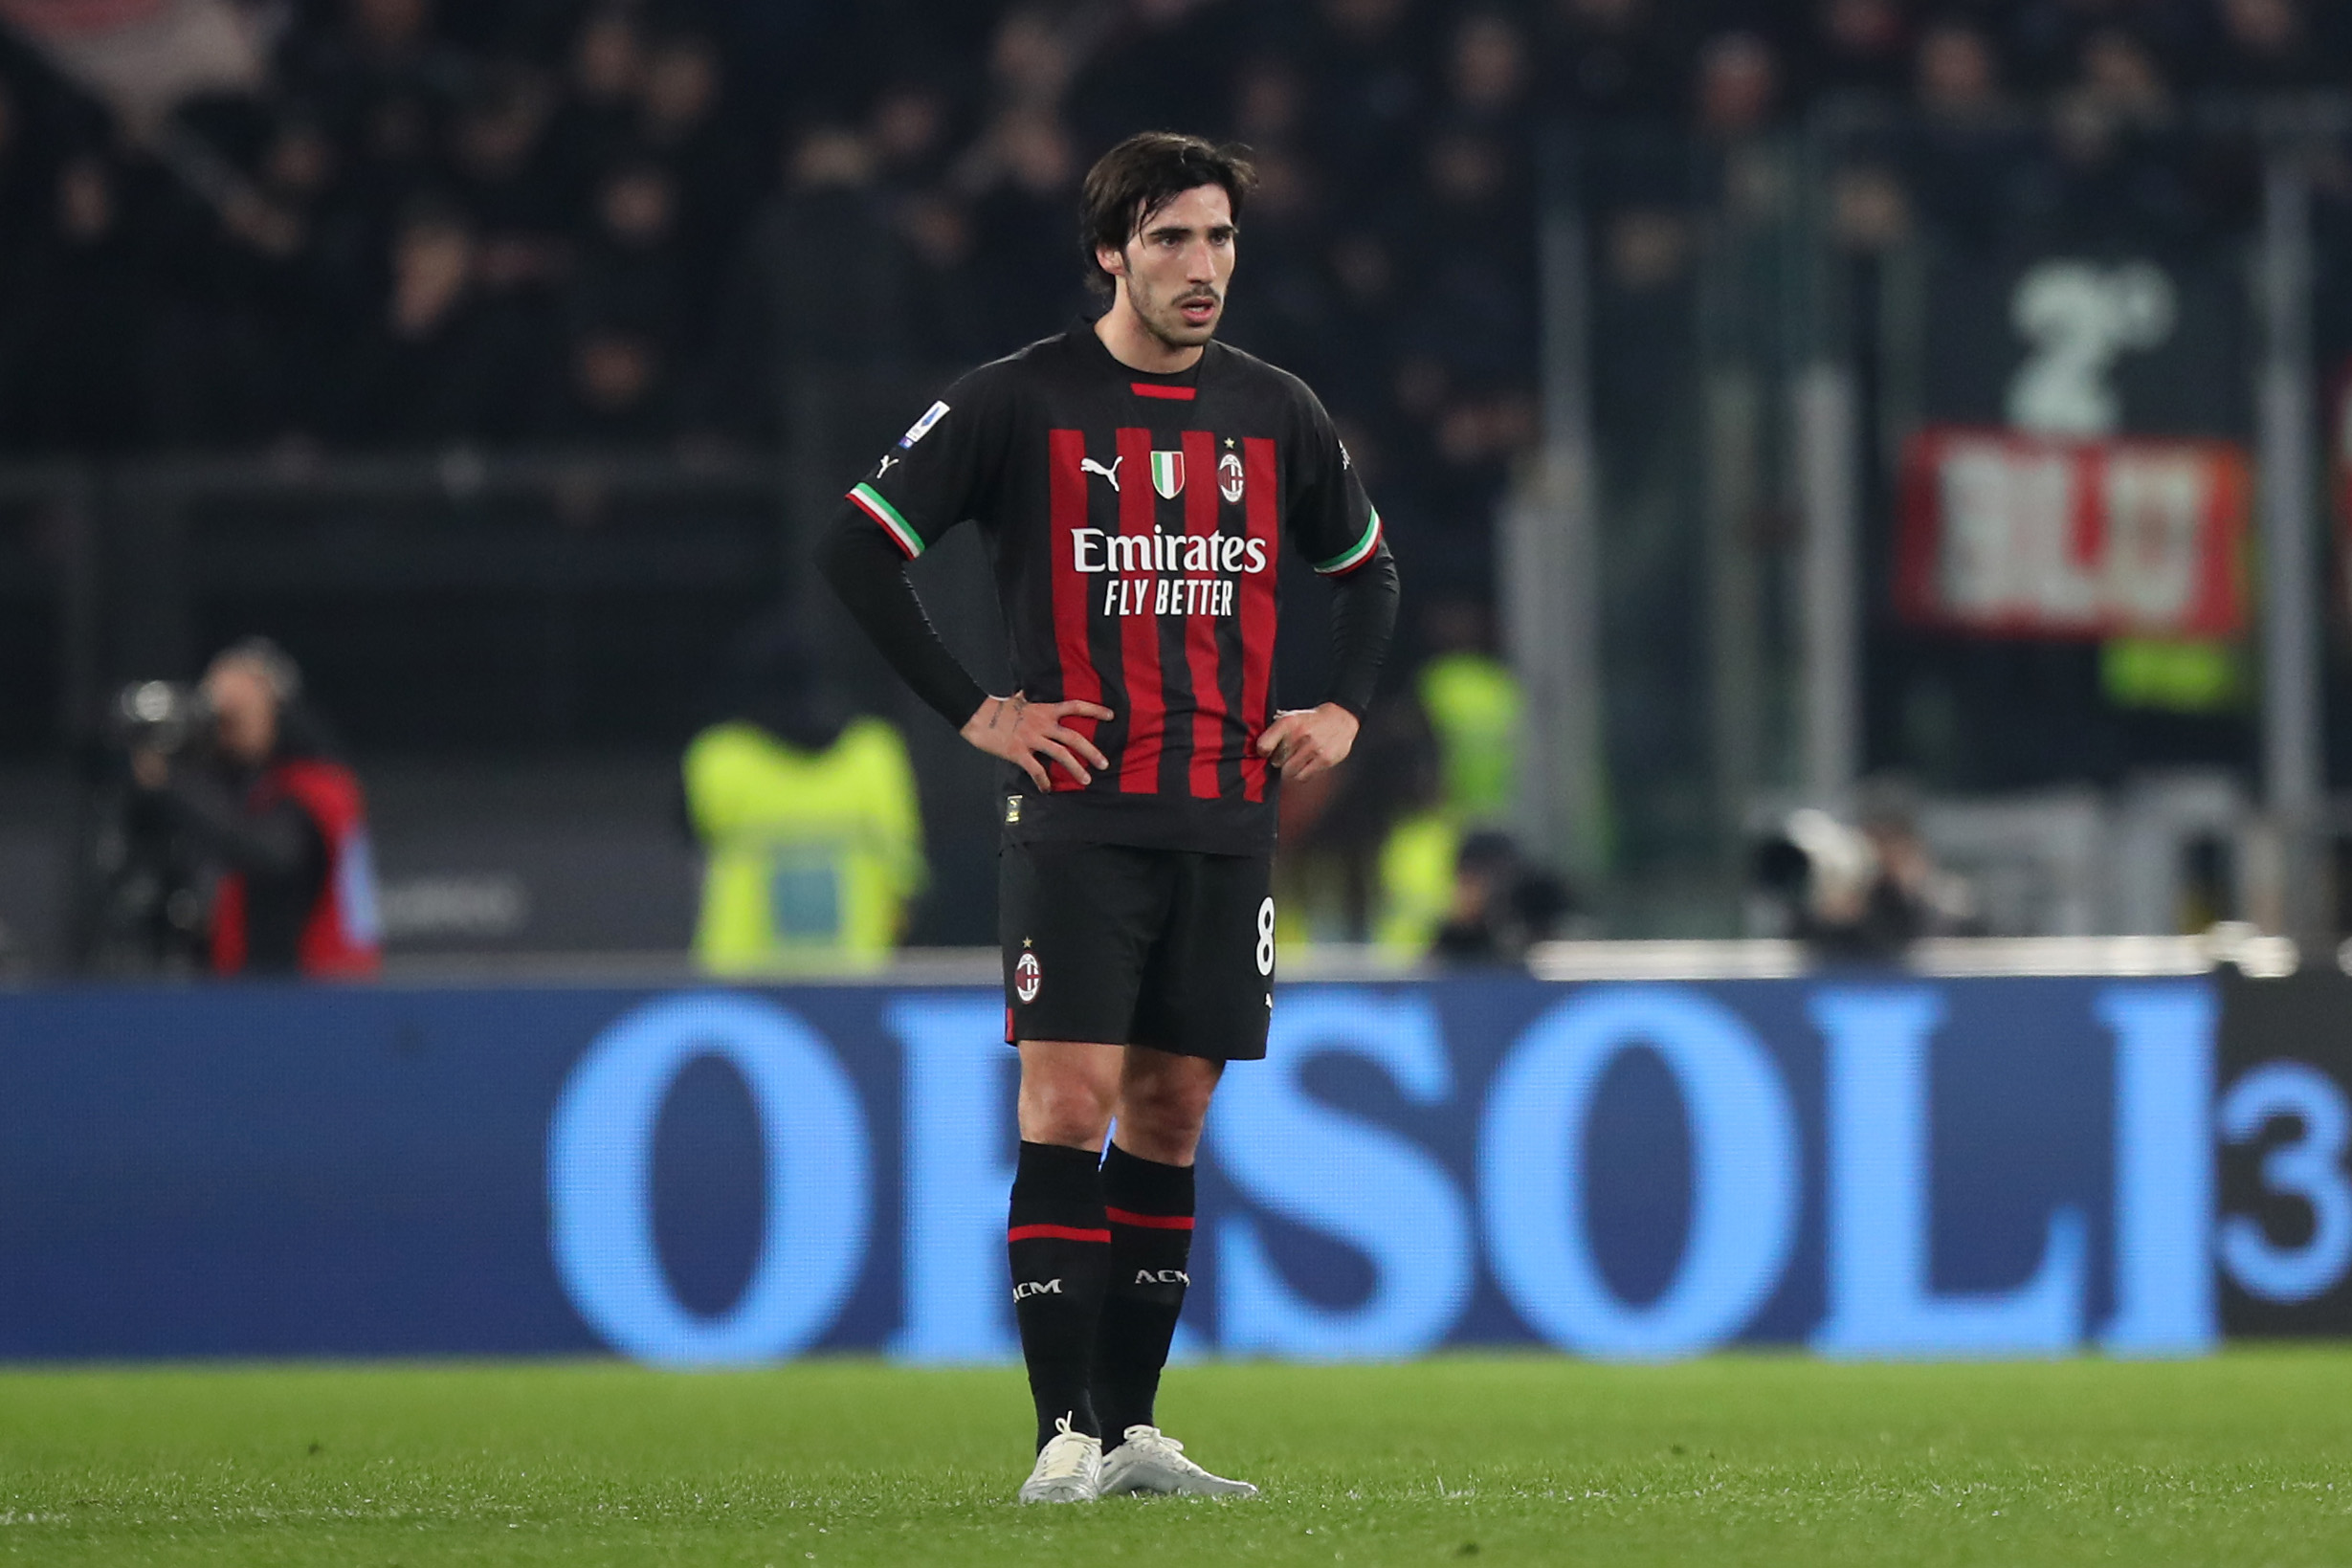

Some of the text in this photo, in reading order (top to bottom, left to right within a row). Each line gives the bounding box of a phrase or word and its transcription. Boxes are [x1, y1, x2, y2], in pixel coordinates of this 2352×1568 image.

[1070, 523, 1267, 574] Emirates
[1103, 579, 1234, 617] FLY BETTER
[1255, 896, 1276, 977] 8
[2217, 1061, 2352, 1304] 3
